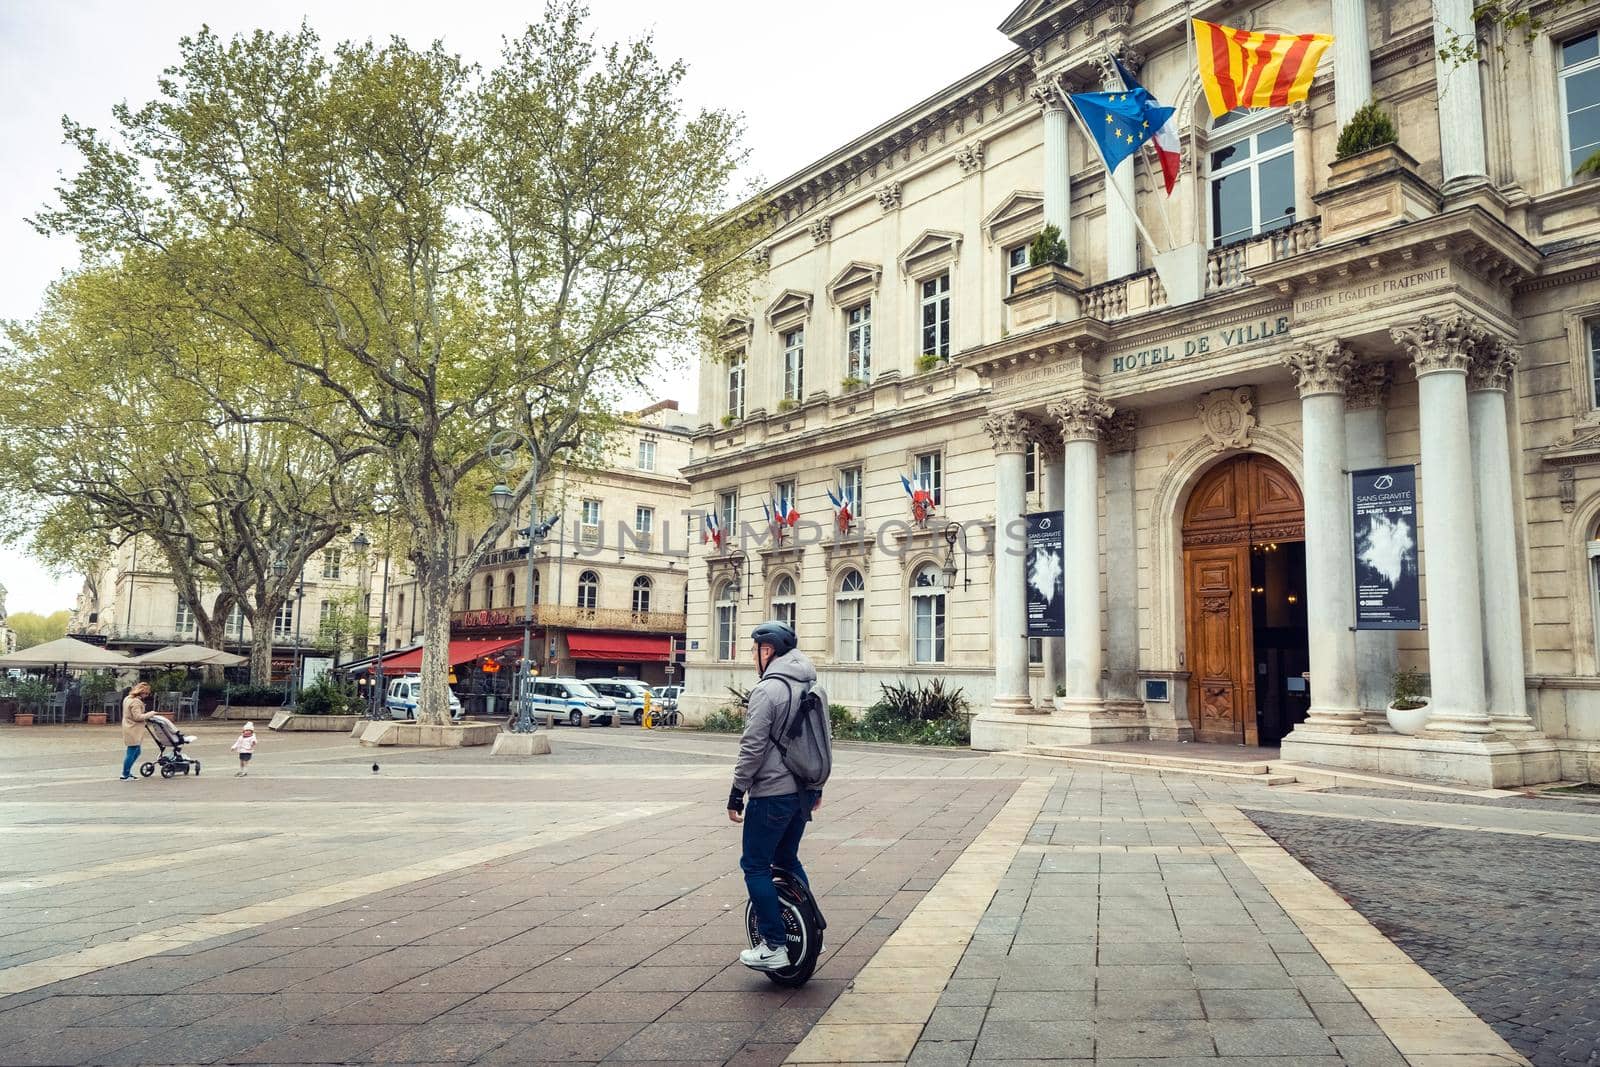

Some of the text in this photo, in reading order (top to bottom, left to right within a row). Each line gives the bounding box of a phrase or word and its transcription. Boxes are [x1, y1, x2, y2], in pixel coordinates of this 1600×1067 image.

[1295, 266, 1448, 313] LIBERTE EGALITE FRATERNITE
[1112, 316, 1289, 373] HOTEL DE VILLE
[1356, 494, 1378, 502] SANS
